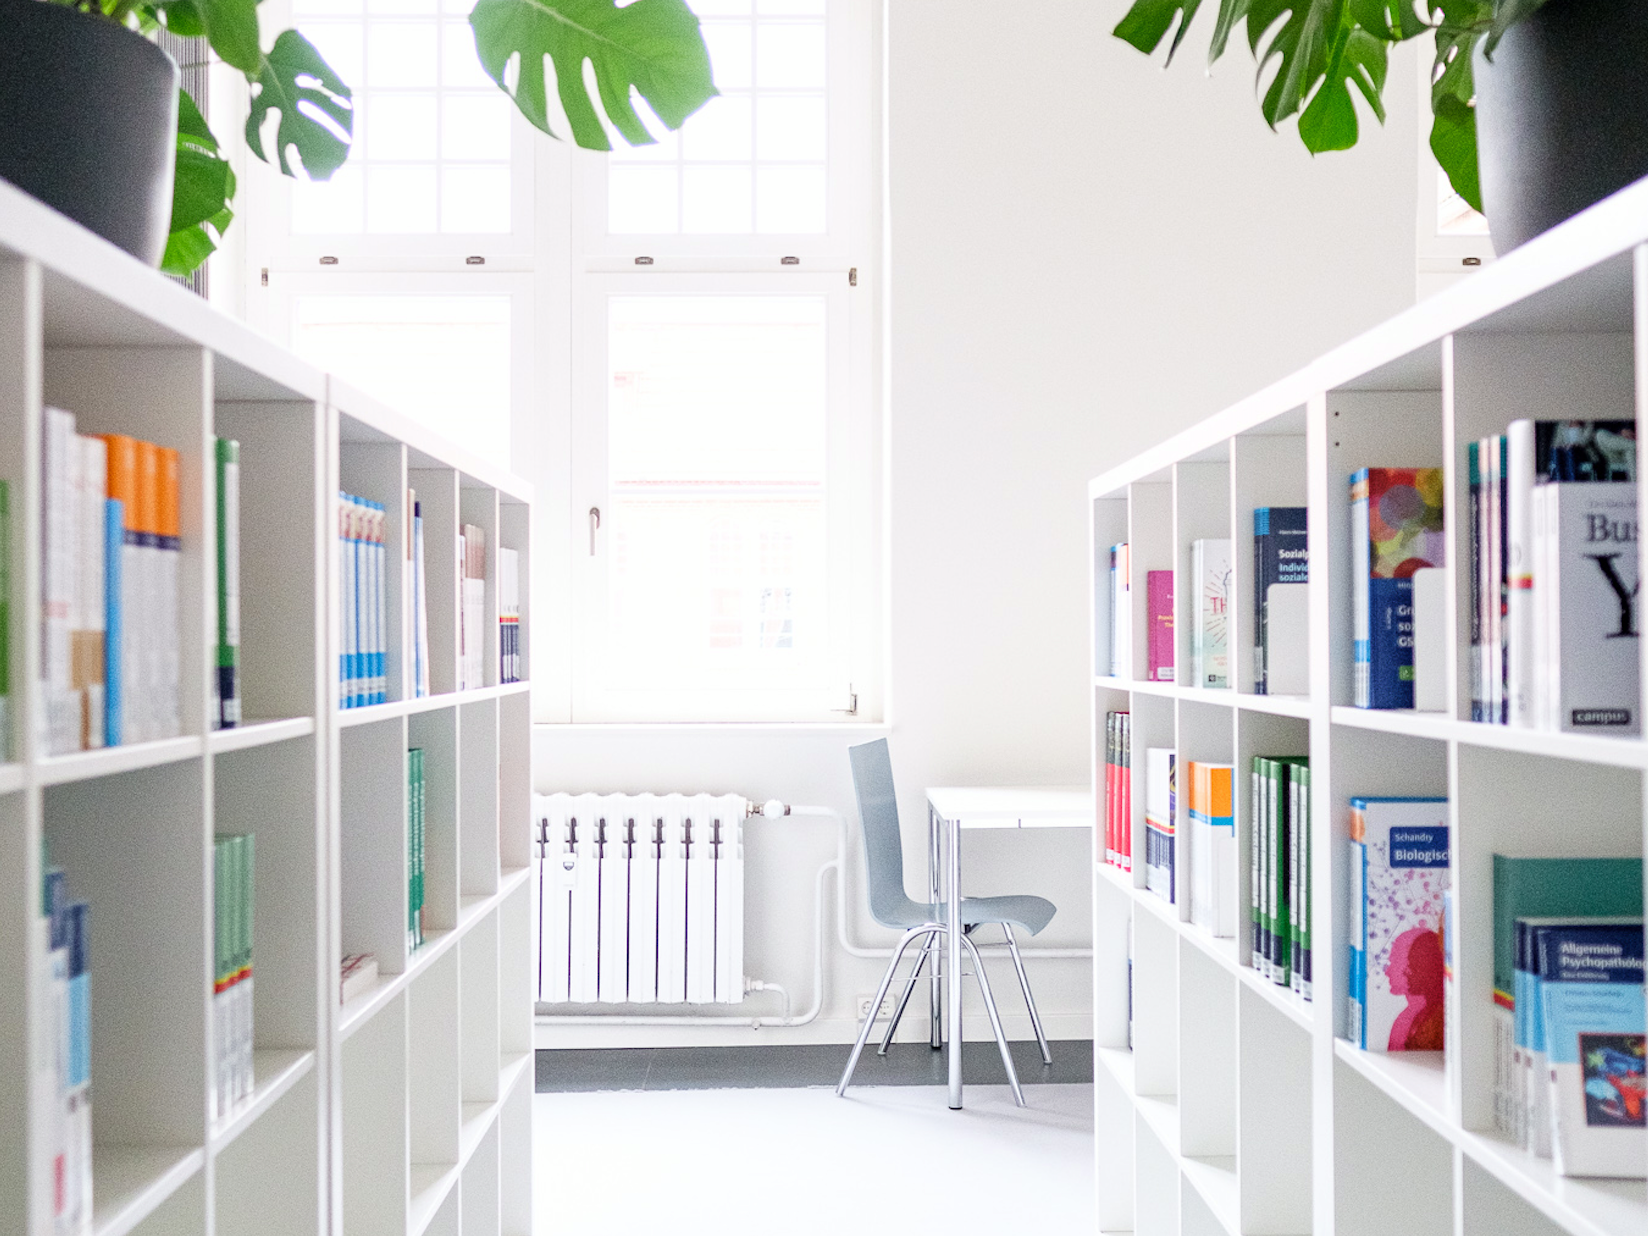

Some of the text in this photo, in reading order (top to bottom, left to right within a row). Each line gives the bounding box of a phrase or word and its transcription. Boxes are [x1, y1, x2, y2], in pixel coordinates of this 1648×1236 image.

[1577, 712, 1625, 725] campus
[1394, 832, 1434, 843] Schandry
[1561, 943, 1622, 956] Allgemeine
